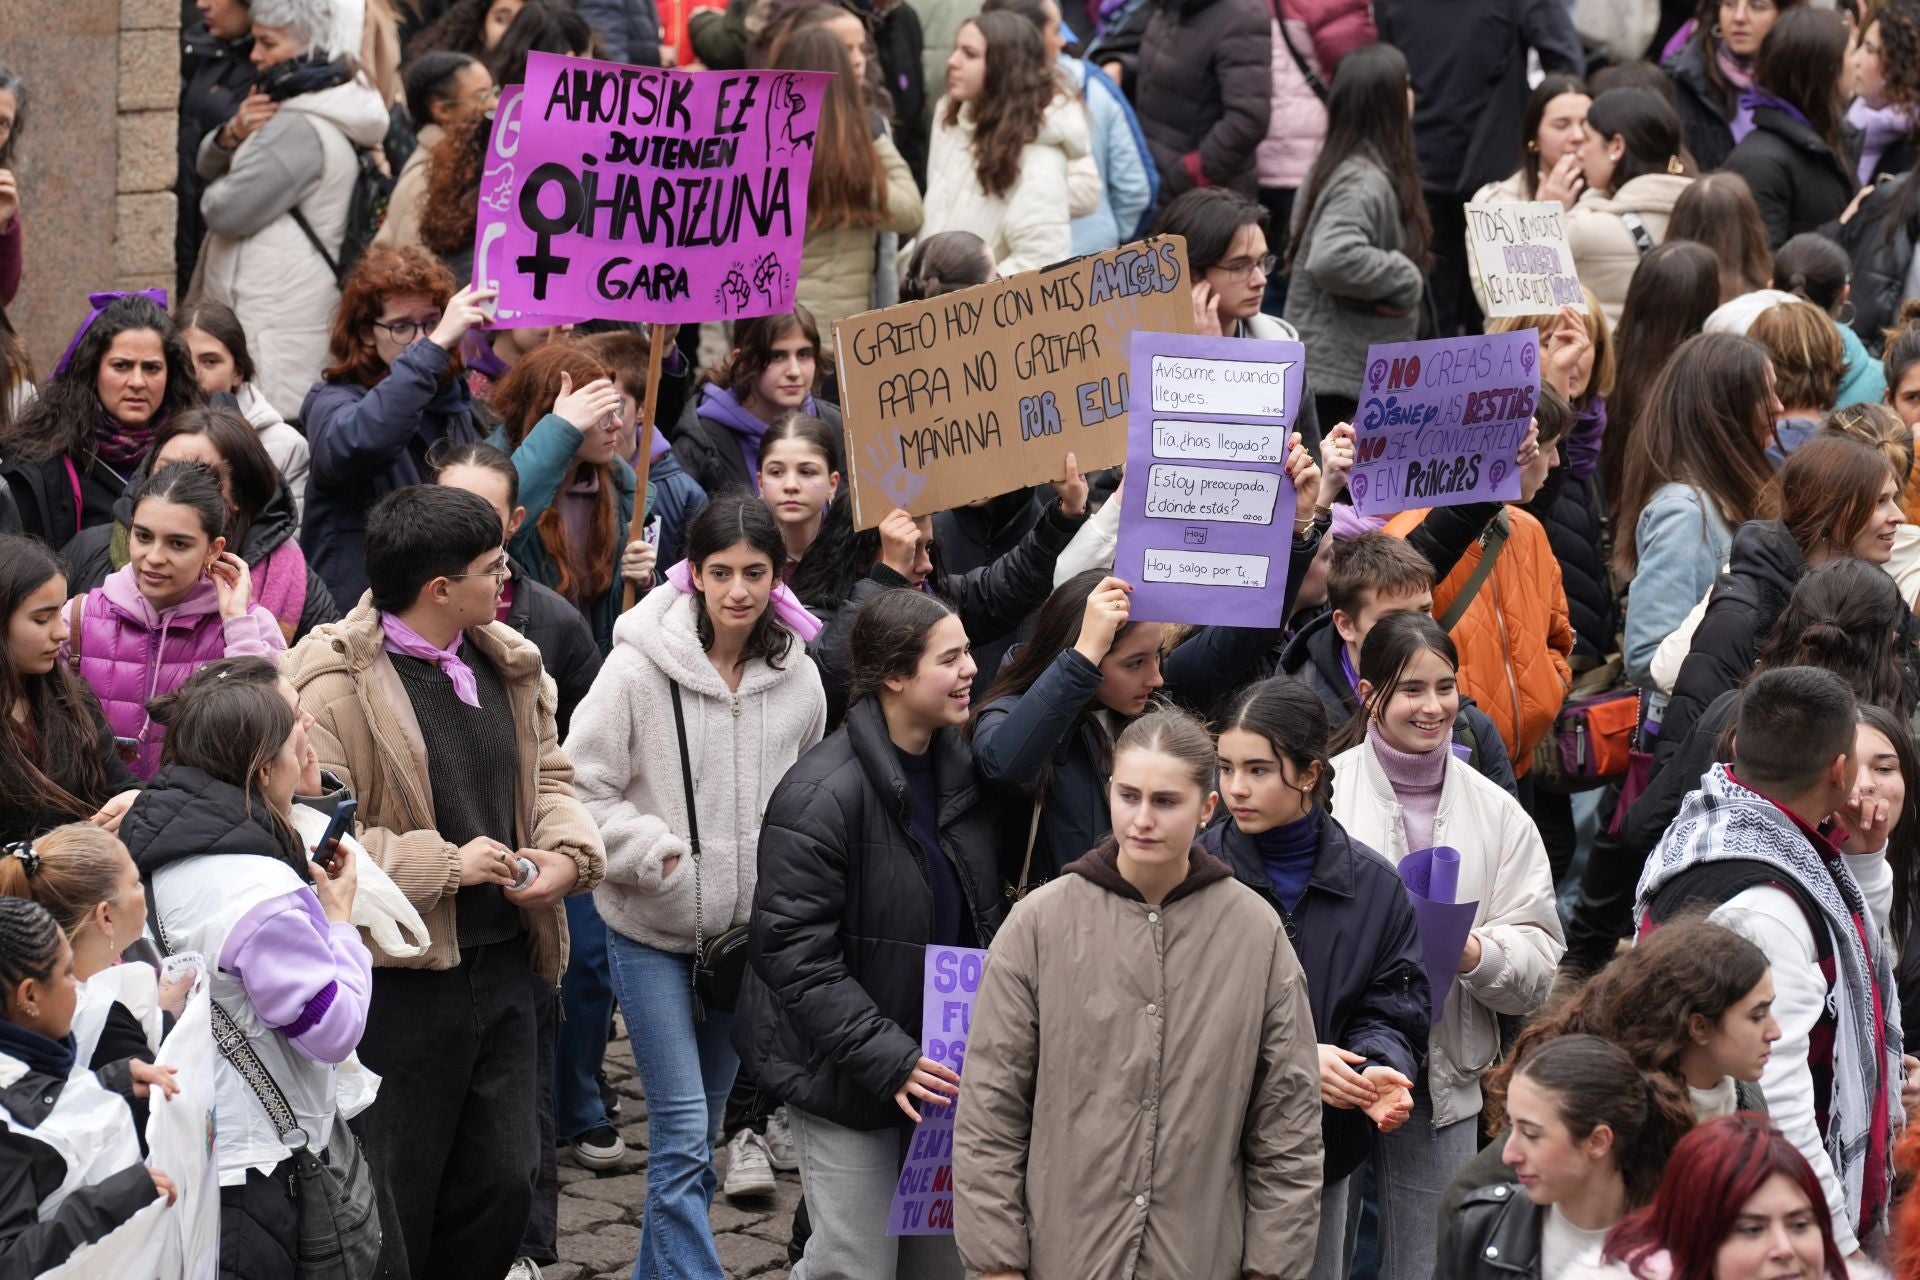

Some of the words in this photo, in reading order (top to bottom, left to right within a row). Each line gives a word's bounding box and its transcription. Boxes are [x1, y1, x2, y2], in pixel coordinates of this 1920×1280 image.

[714, 76, 760, 135] EZ
[605, 131, 740, 170] DUTENEN
[1468, 208, 1515, 244] TODAS
[596, 256, 691, 302] GARA
[852, 311, 937, 367] GRITO
[944, 297, 984, 341] HOY
[993, 288, 1034, 328] CON
[1040, 271, 1085, 312] MIS
[1089, 243, 1182, 307] AMIGAS
[878, 366, 952, 420] PARA
[963, 350, 998, 397] NO
[1014, 323, 1102, 381] GRITAR
[1154, 361, 1216, 384] Avísame
[1223, 366, 1281, 386] cuando
[1386, 355, 1422, 390] NO
[1424, 343, 1492, 388] CREAS
[1498, 343, 1514, 377] A
[1434, 394, 1464, 426] LAS
[899, 410, 1003, 470] MAÑANA
[1018, 390, 1063, 442] POR
[1179, 429, 1211, 452] ¿has
[1217, 432, 1271, 458] llegado?
[1356, 435, 1388, 465] NO
[1386, 430, 1414, 460] SE
[1418, 421, 1527, 459] CONVIERTEN
[1153, 466, 1196, 497] Estoy
[1374, 464, 1402, 502] EN
[1147, 491, 1197, 515] ¿dónde
[1199, 498, 1240, 516] estás?
[1186, 530, 1205, 544] Hoy
[1146, 557, 1173, 579] Hoy
[1178, 561, 1208, 577] salgo
[1212, 564, 1231, 579] por
[899, 1166, 933, 1197] QUE
[902, 1200, 925, 1230] TU
